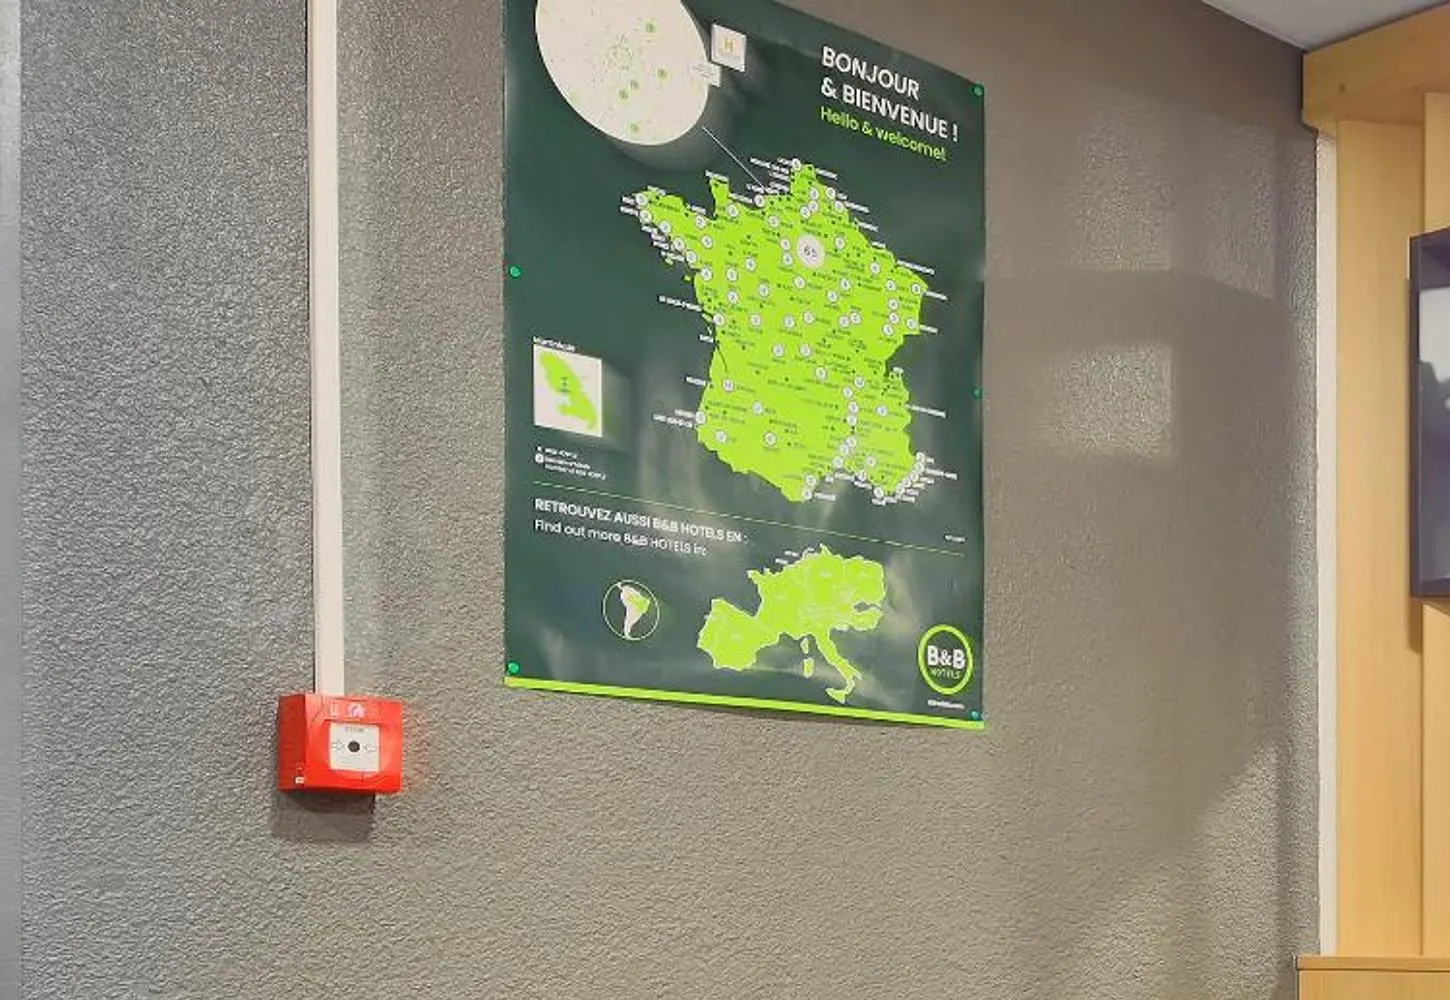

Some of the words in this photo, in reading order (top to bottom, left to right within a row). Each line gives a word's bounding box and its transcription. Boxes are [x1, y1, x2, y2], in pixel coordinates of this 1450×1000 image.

[822, 46, 919, 101] BONJOUR
[820, 106, 860, 131] Hello
[862, 121, 873, 137] &
[876, 127, 947, 161] welcome!
[821, 77, 838, 99] &
[843, 84, 948, 139] BIENVENUE
[952, 123, 958, 142] !
[535, 498, 612, 521] RETROUVEZ
[613, 511, 650, 529] AUSSI
[653, 517, 679, 533] B&B
[681, 522, 725, 541] HOTELS
[726, 530, 742, 543] EN
[535, 519, 562, 533] Find
[564, 524, 586, 539] out
[587, 528, 621, 543] more
[651, 537, 692, 554] HOTELS
[927, 644, 966, 669] B&B
